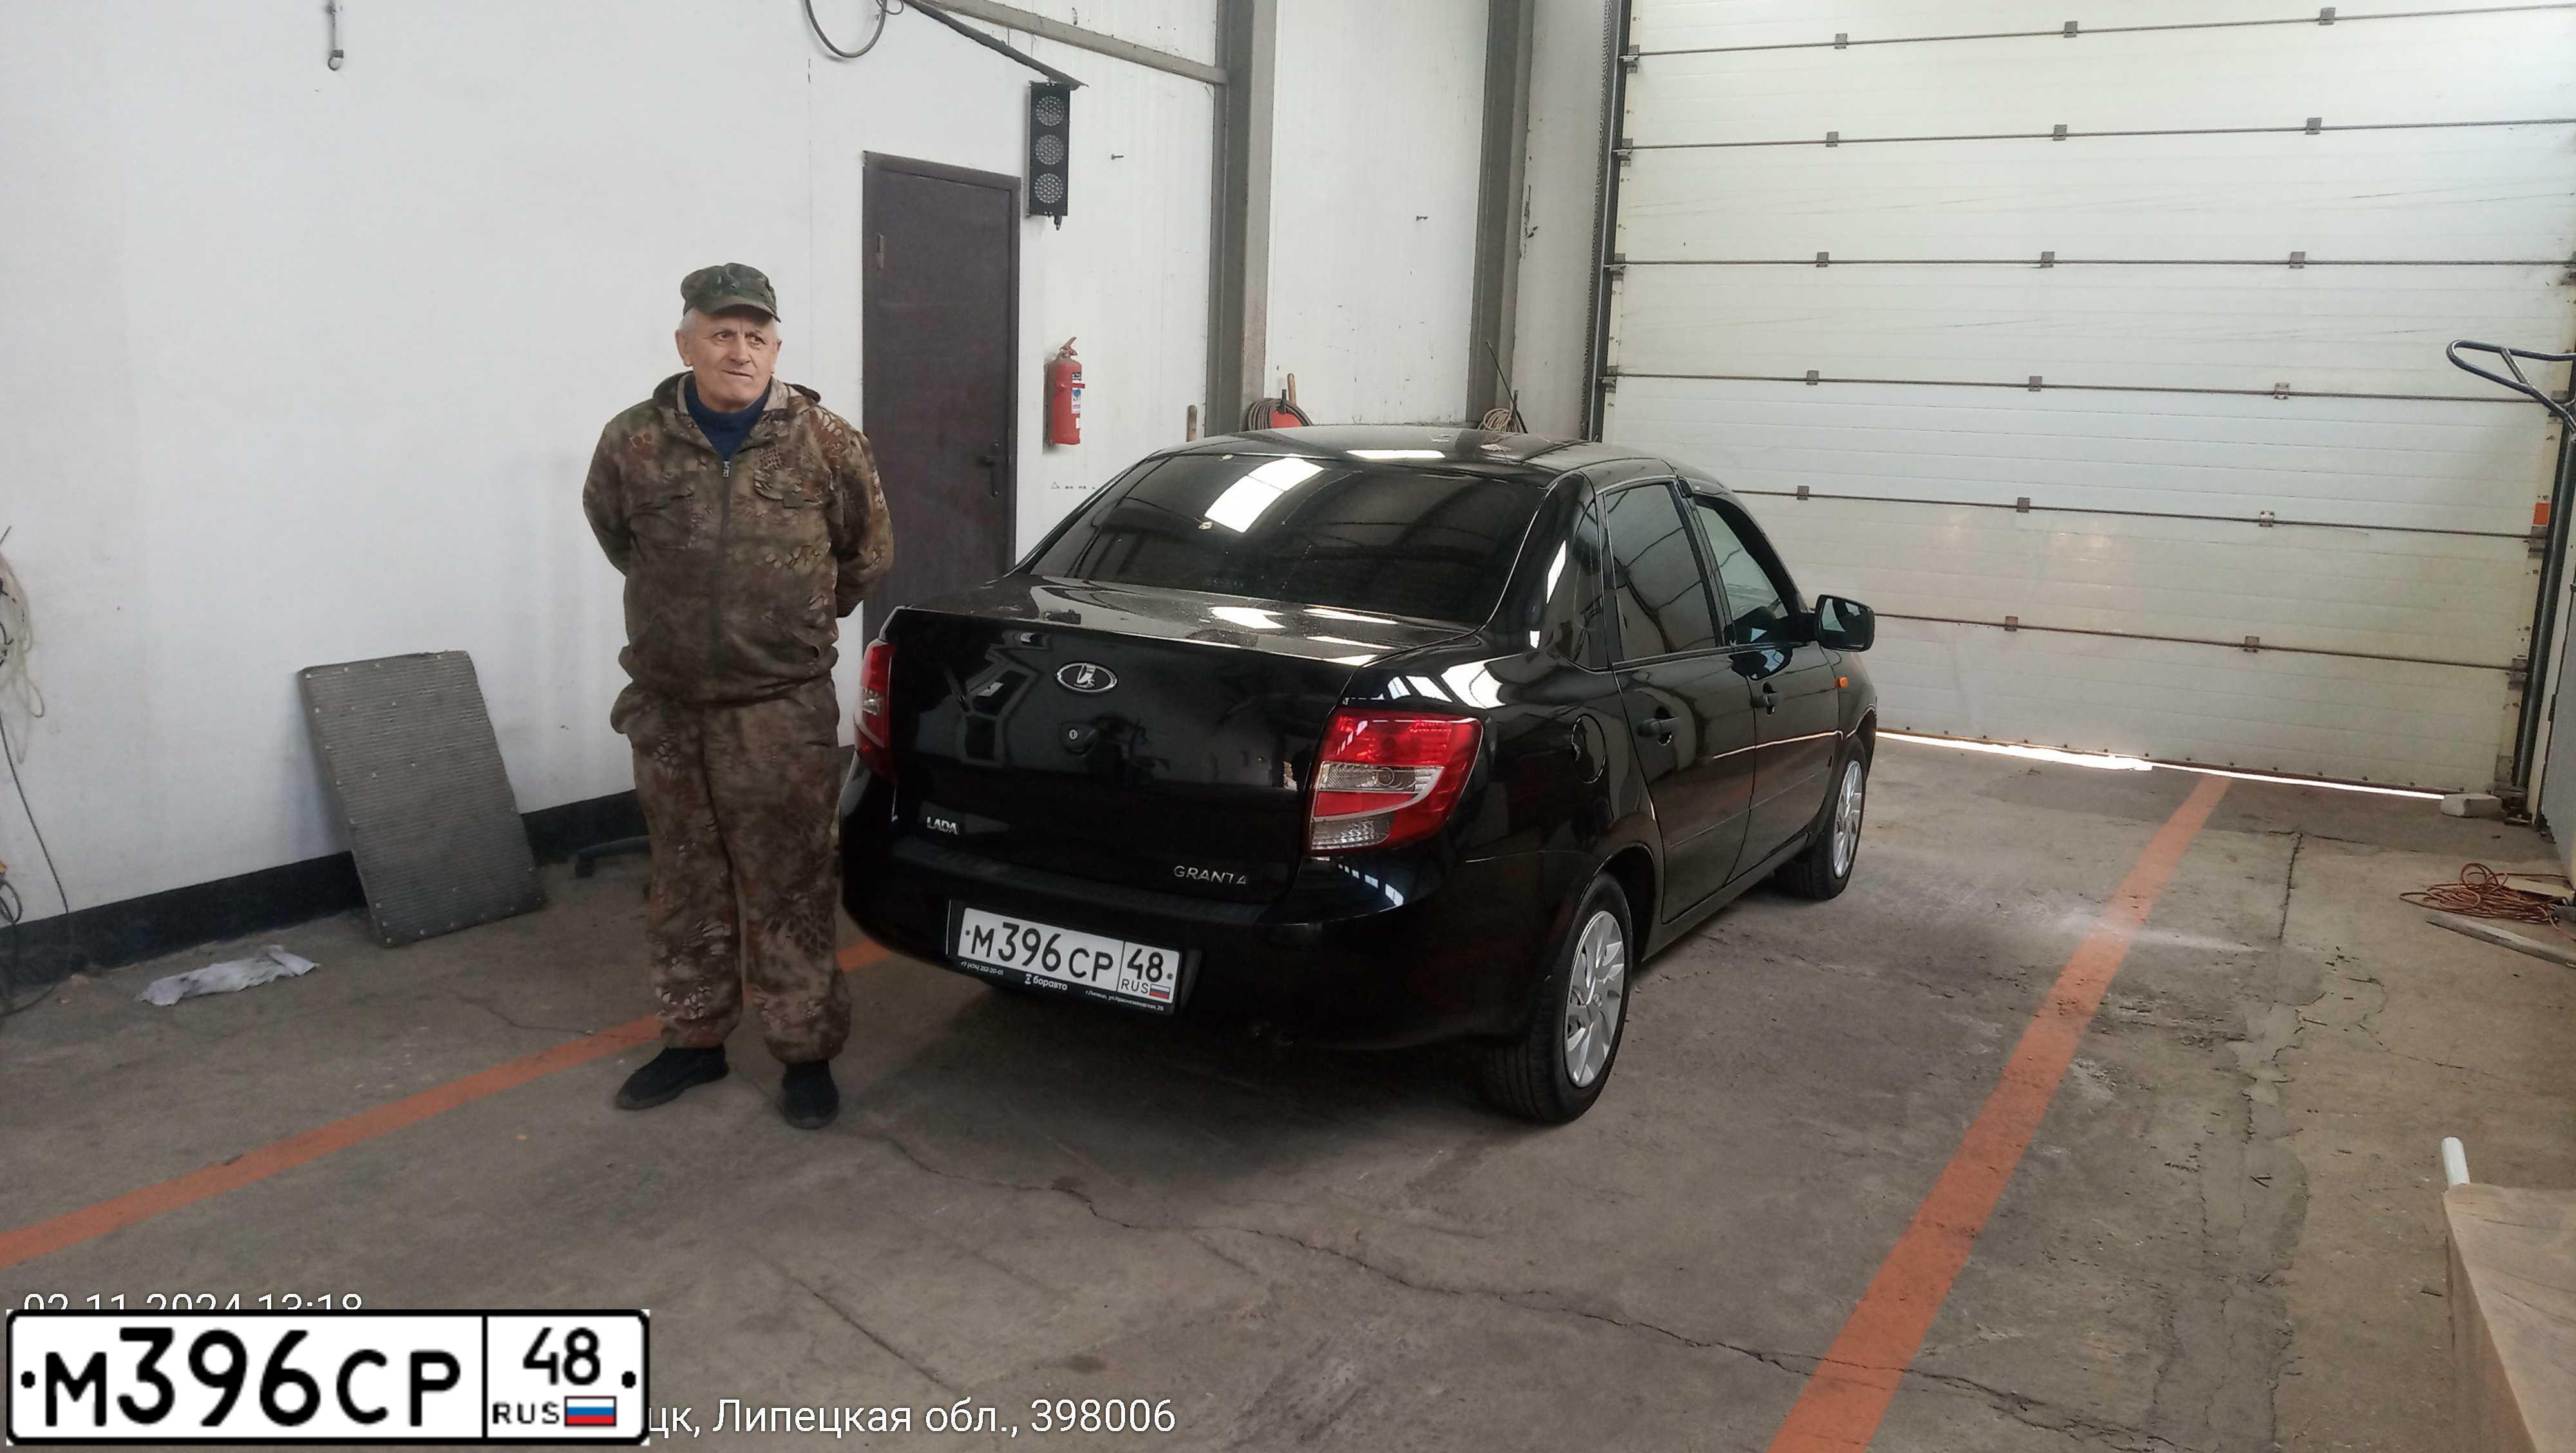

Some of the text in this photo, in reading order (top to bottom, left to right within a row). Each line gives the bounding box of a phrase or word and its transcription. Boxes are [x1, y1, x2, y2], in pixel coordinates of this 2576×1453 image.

[927, 816, 958, 835] LADA
[1174, 865, 1247, 885] GRANTA
[1127, 948, 1164, 982] 48
[1121, 978, 1149, 994] RUS
